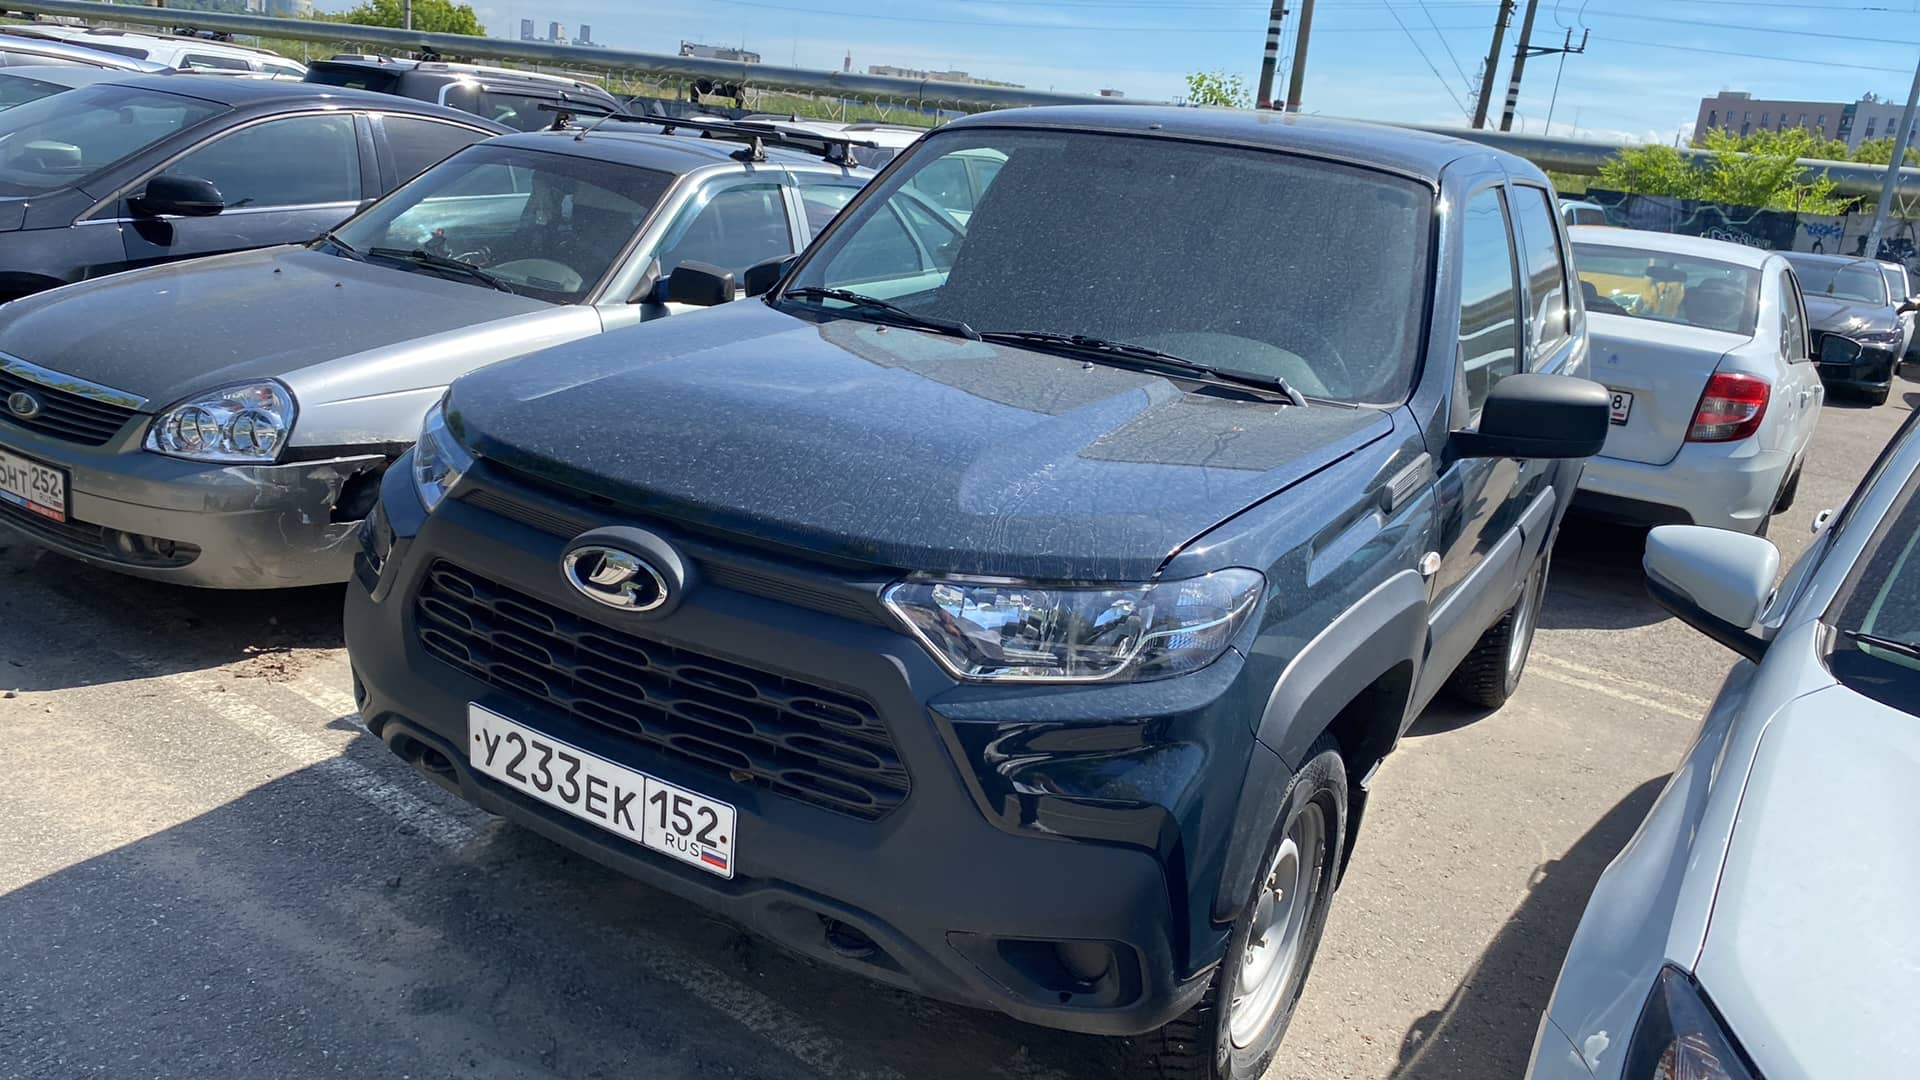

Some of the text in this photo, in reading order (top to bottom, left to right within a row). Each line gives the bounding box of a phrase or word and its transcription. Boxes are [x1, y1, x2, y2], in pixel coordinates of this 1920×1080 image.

[31, 466, 58, 497] 252
[483, 728, 718, 848] У233ЕК 152
[665, 833, 700, 857] RUS
